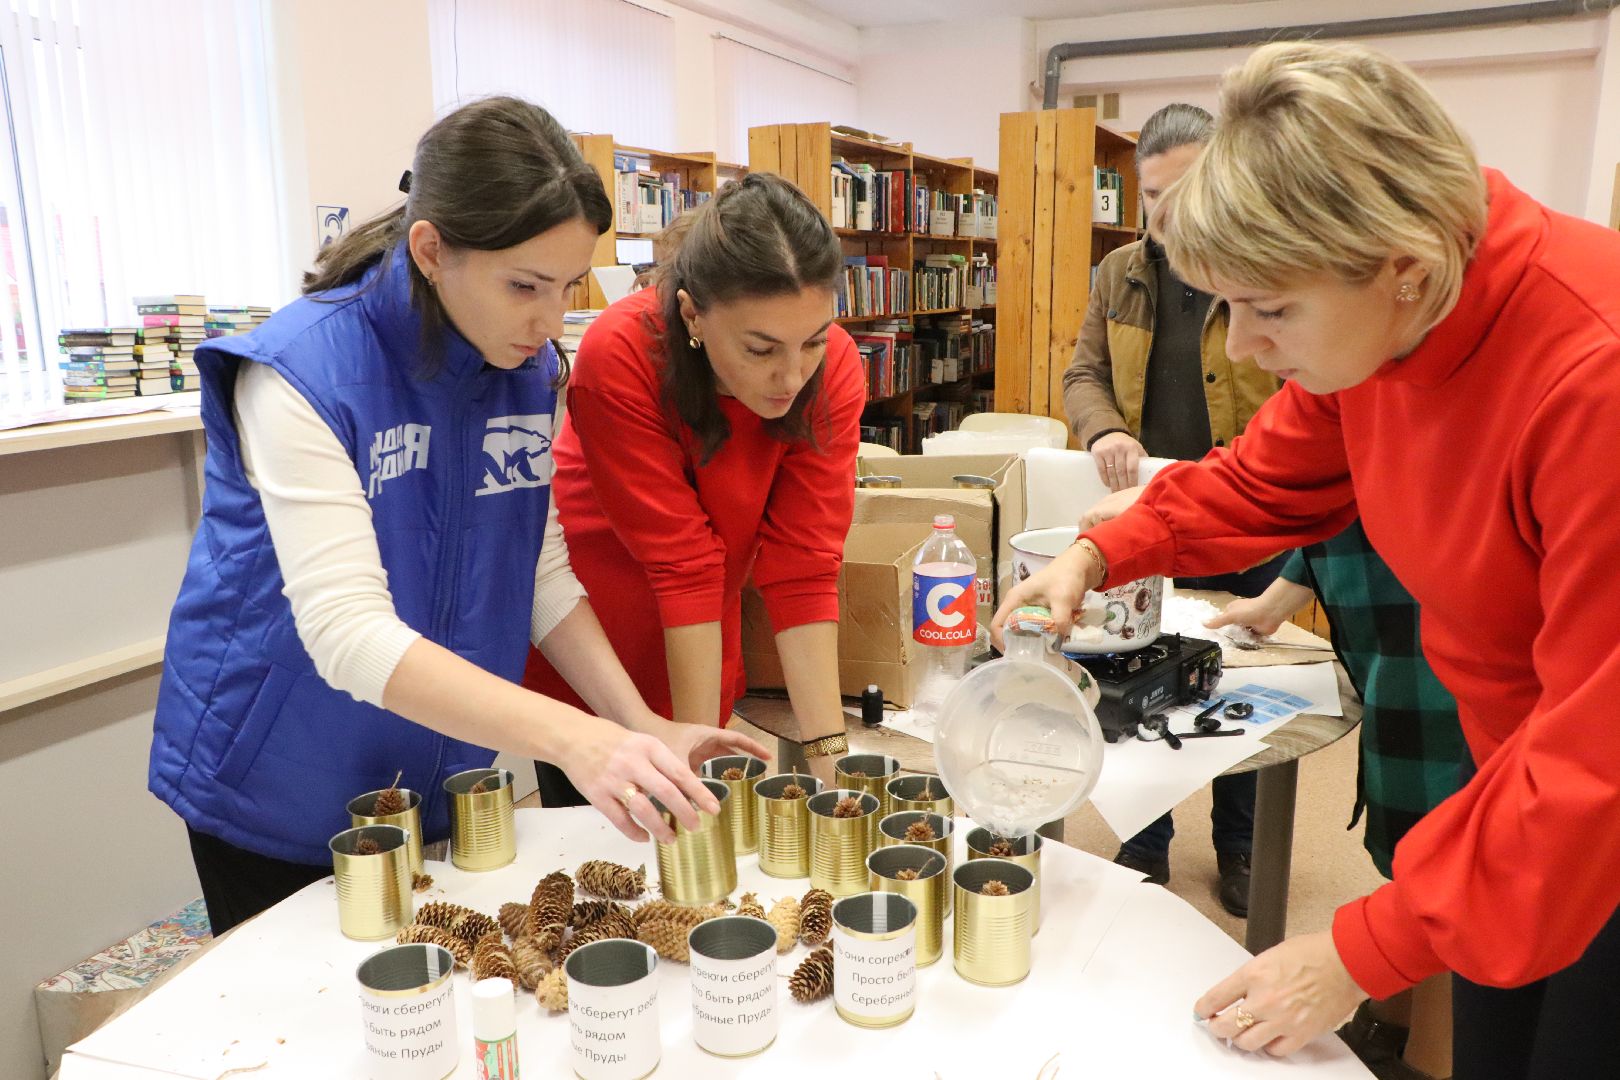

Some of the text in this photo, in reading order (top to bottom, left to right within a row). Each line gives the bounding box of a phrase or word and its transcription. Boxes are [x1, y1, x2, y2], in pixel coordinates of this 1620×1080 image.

[1101, 195, 1110, 211] 3
[919, 629, 972, 640] COOLCOLA
[852, 972, 894, 986] Просто
[705, 990, 734, 1004] быть
[737, 984, 772, 1005] рядом
[580, 1006, 635, 1020] сберегут
[369, 1022, 396, 1038] быть
[400, 1019, 442, 1039] рядом
[585, 1030, 626, 1042] рядом
[401, 1040, 443, 1060] Пруды
[585, 1048, 627, 1064] Пруды
